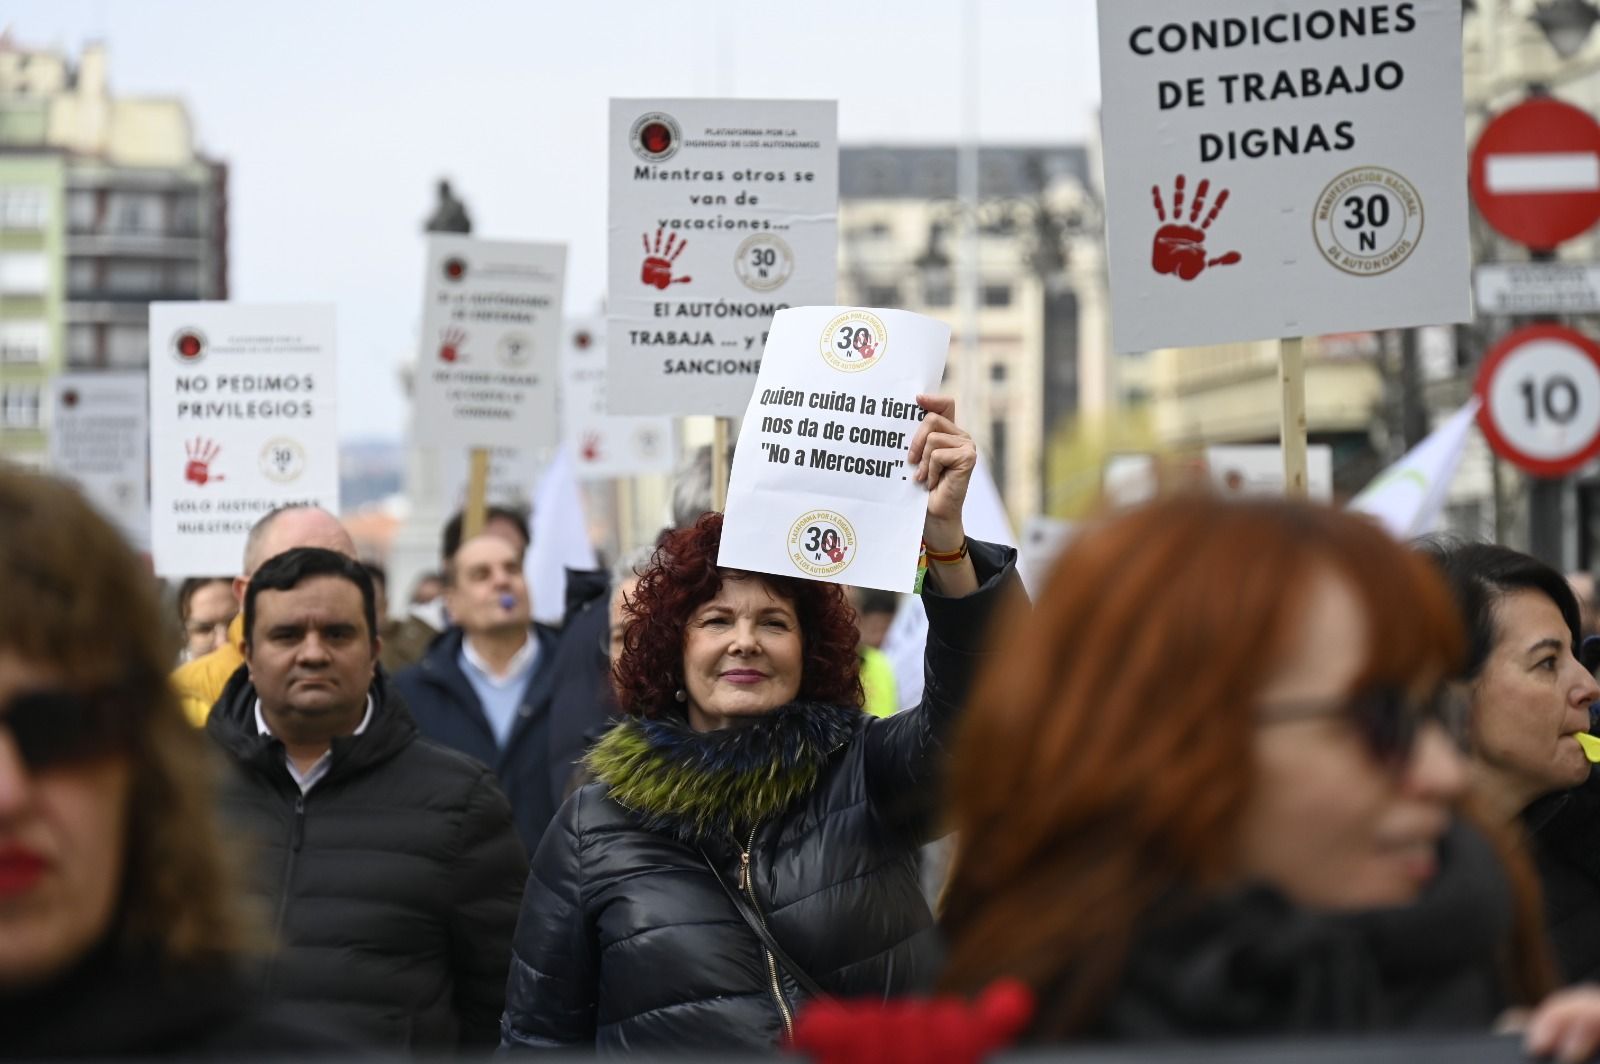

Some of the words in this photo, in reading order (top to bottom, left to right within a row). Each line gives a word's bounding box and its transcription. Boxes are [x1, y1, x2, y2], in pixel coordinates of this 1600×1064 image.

[1129, 2, 1416, 56] CONDICIONES
[1158, 77, 1205, 111] DE
[1218, 60, 1404, 104] TRABAJO
[1200, 120, 1356, 163] DIGNAS
[634, 165, 725, 181] Mientras
[732, 168, 787, 182] otros
[793, 170, 815, 182] se
[689, 194, 727, 205] van
[735, 190, 759, 205] de
[1343, 193, 1390, 230] 30
[658, 215, 791, 230] vacaciones...
[1359, 230, 1376, 251] N
[751, 248, 776, 267] 30
[1328, 246, 1342, 260] DE
[653, 302, 670, 318] El
[629, 331, 715, 346] TRABAJA
[744, 335, 755, 350] y
[837, 326, 870, 351] 30
[846, 350, 853, 358] N
[175, 376, 208, 394] NO
[216, 375, 314, 394] PEDIMOS
[760, 386, 804, 407] Quien
[808, 391, 856, 413] cuida
[860, 395, 876, 416] la
[881, 397, 928, 422] tierra
[1520, 373, 1580, 426] 10
[177, 401, 314, 419] PRIVILEGIOS
[761, 416, 794, 435] nos
[797, 417, 819, 438] da
[822, 421, 845, 441] de
[849, 426, 909, 450] comer.
[761, 442, 790, 464] "No
[794, 449, 806, 466] a
[809, 448, 907, 481] Mercosur".
[172, 499, 211, 513] SOLO
[791, 514, 817, 544] PLATAFORMA
[817, 512, 829, 520] POR
[836, 519, 854, 545] DIGNIDAD
[805, 526, 838, 554] 30
[793, 553, 801, 561] DE
[800, 559, 809, 570] LOS
